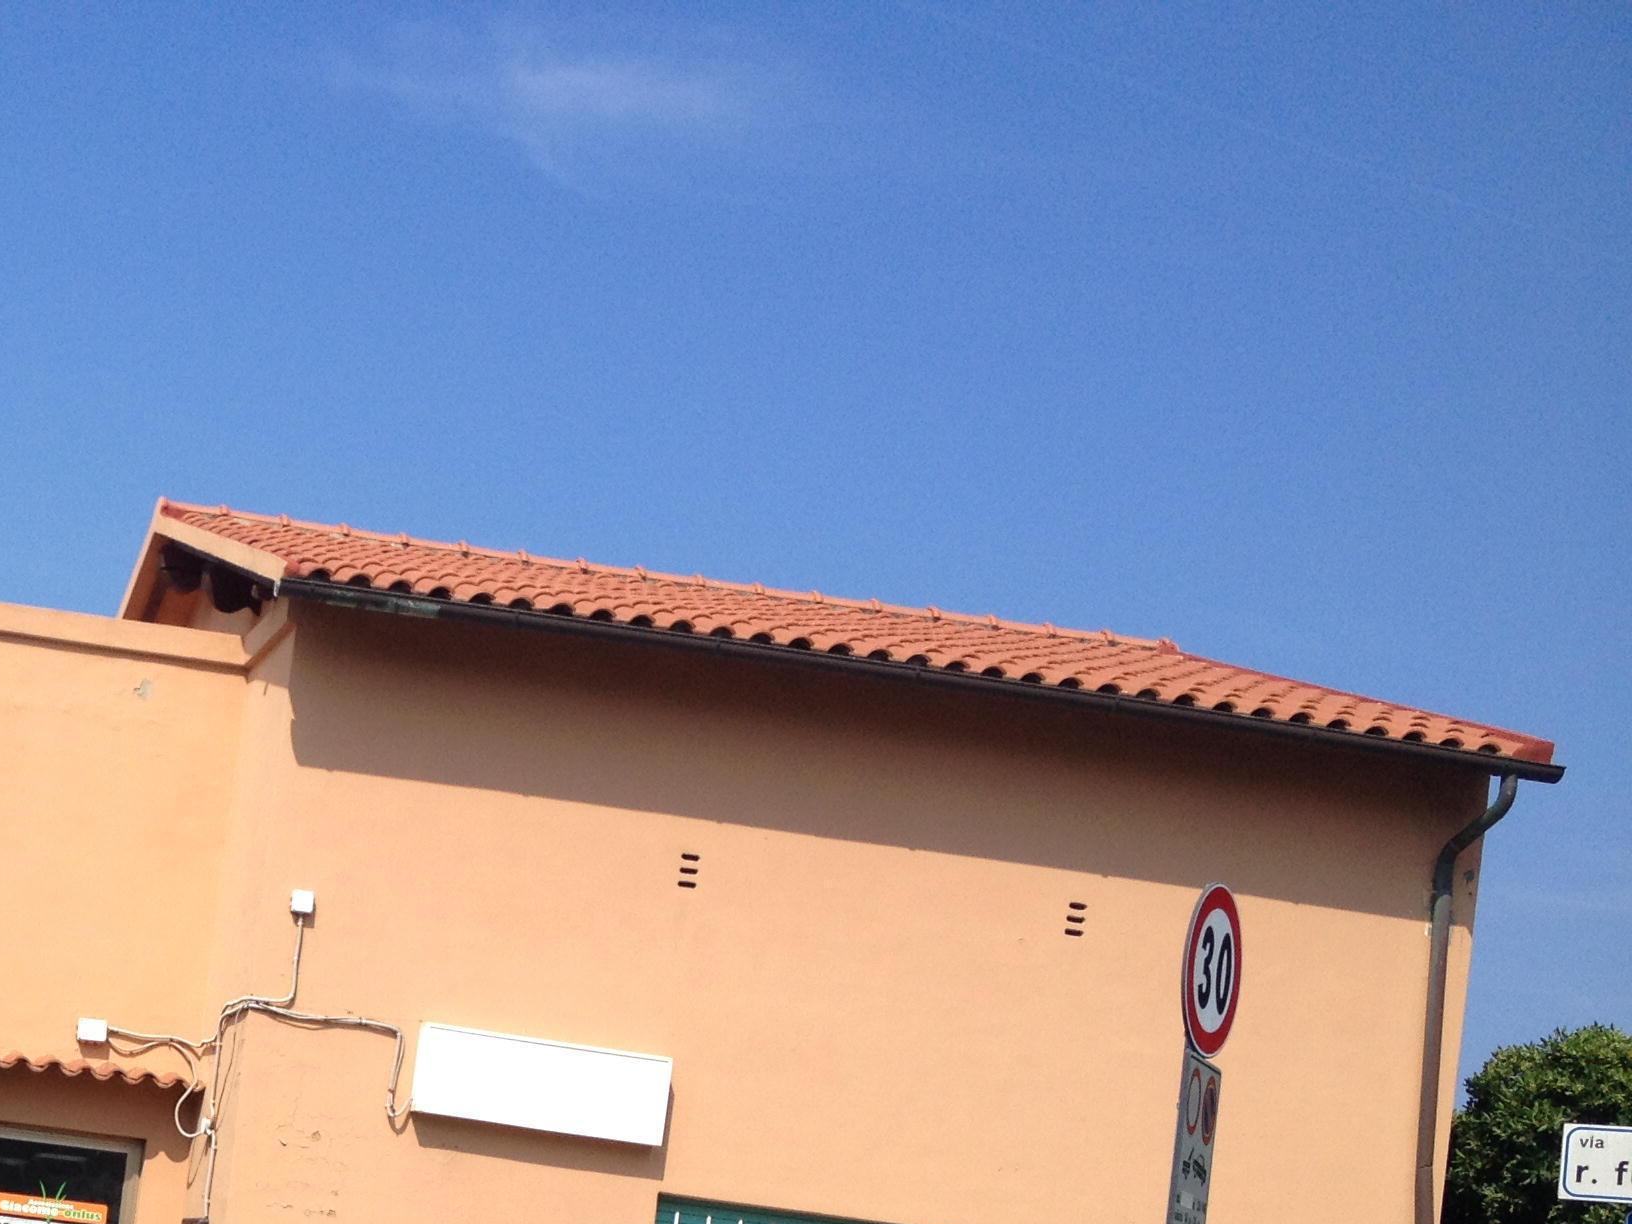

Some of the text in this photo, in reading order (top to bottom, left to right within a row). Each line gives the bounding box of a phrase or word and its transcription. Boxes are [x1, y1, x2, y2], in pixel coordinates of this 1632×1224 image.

[1197, 925, 1232, 1015] 30
[1579, 1135, 1604, 1149] via
[1575, 1160, 1632, 1186] r. f
[0, 1199, 102, 1221] Giacomo onlus
